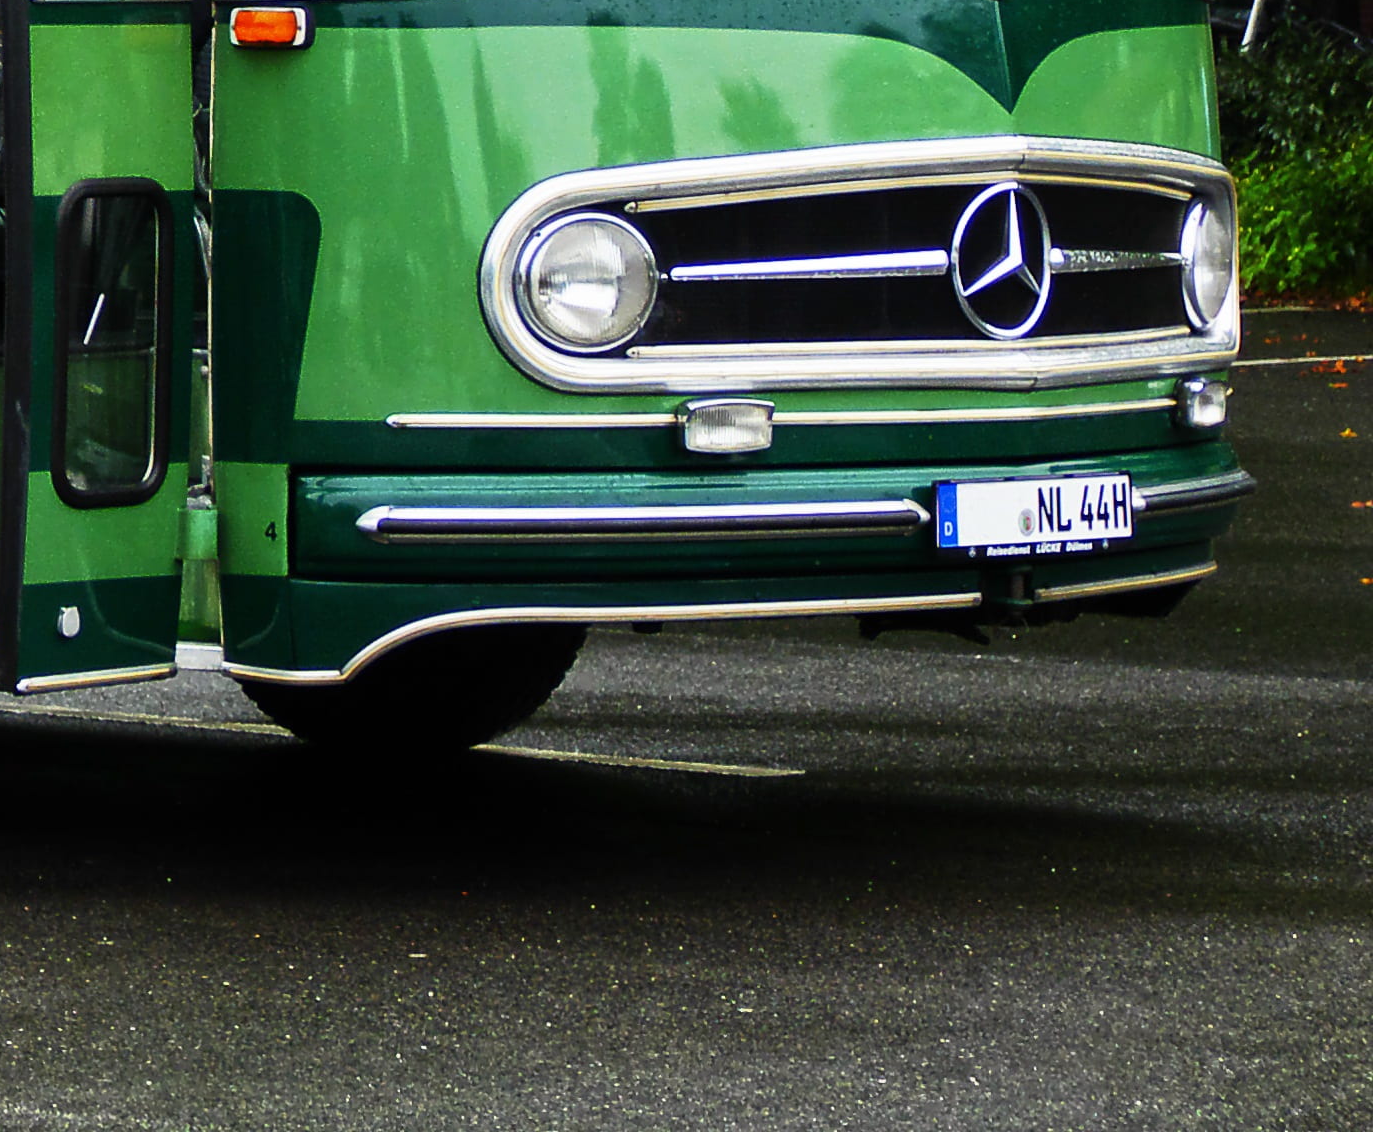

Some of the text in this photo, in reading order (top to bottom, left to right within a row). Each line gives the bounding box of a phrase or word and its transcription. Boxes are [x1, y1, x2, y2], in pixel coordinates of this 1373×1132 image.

[1038, 482, 1128, 532] NL 44H
[264, 521, 277, 542] 4
[944, 521, 953, 536] D
